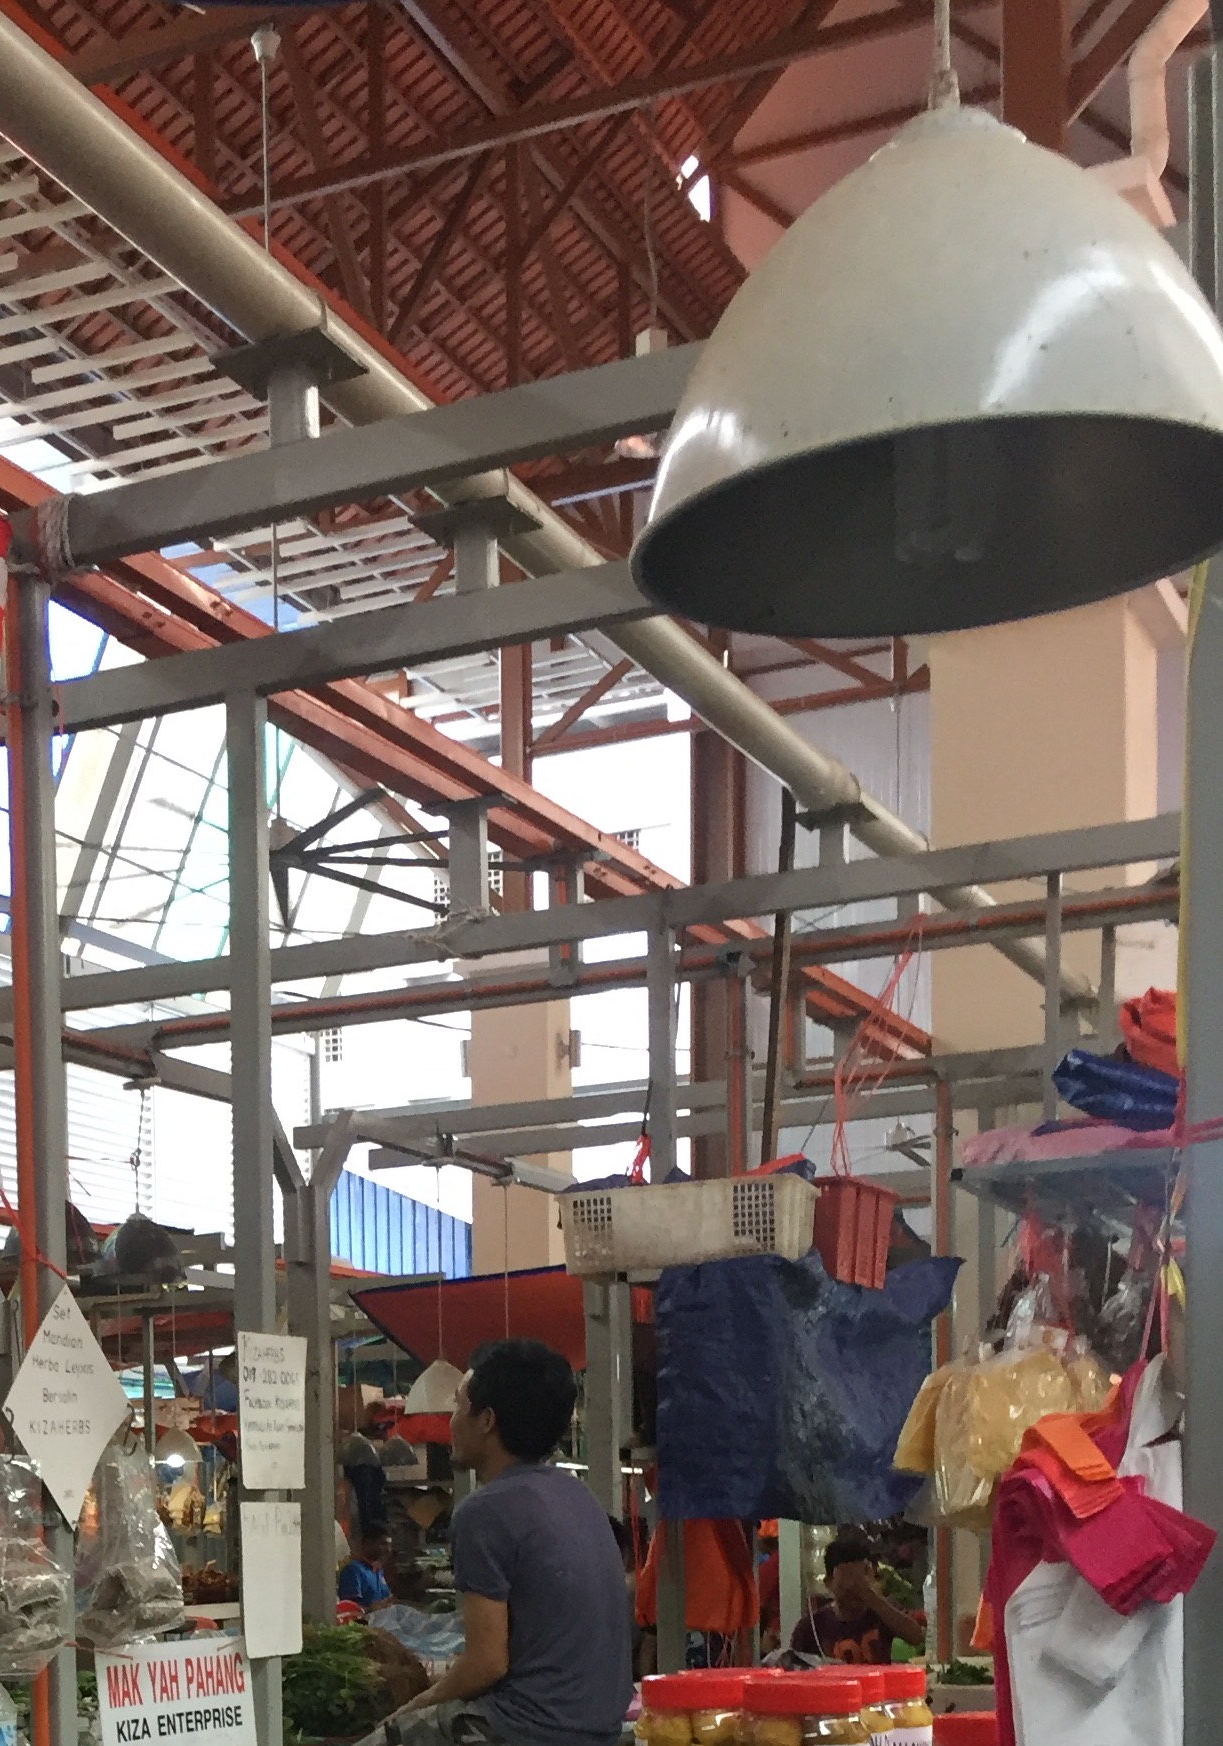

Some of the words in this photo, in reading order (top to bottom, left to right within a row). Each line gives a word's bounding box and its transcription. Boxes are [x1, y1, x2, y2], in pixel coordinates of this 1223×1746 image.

[52, 1304, 71, 1320] Set
[32, 1354, 59, 1373] Herba
[29, 1419, 91, 1436] KIZAHERBS
[106, 1662, 143, 1708] MAK
[147, 1658, 180, 1703] YAH
[184, 1651, 245, 1699] PAHANG
[116, 1717, 151, 1743] KIZA
[157, 1705, 243, 1737] ENTERPRISE
